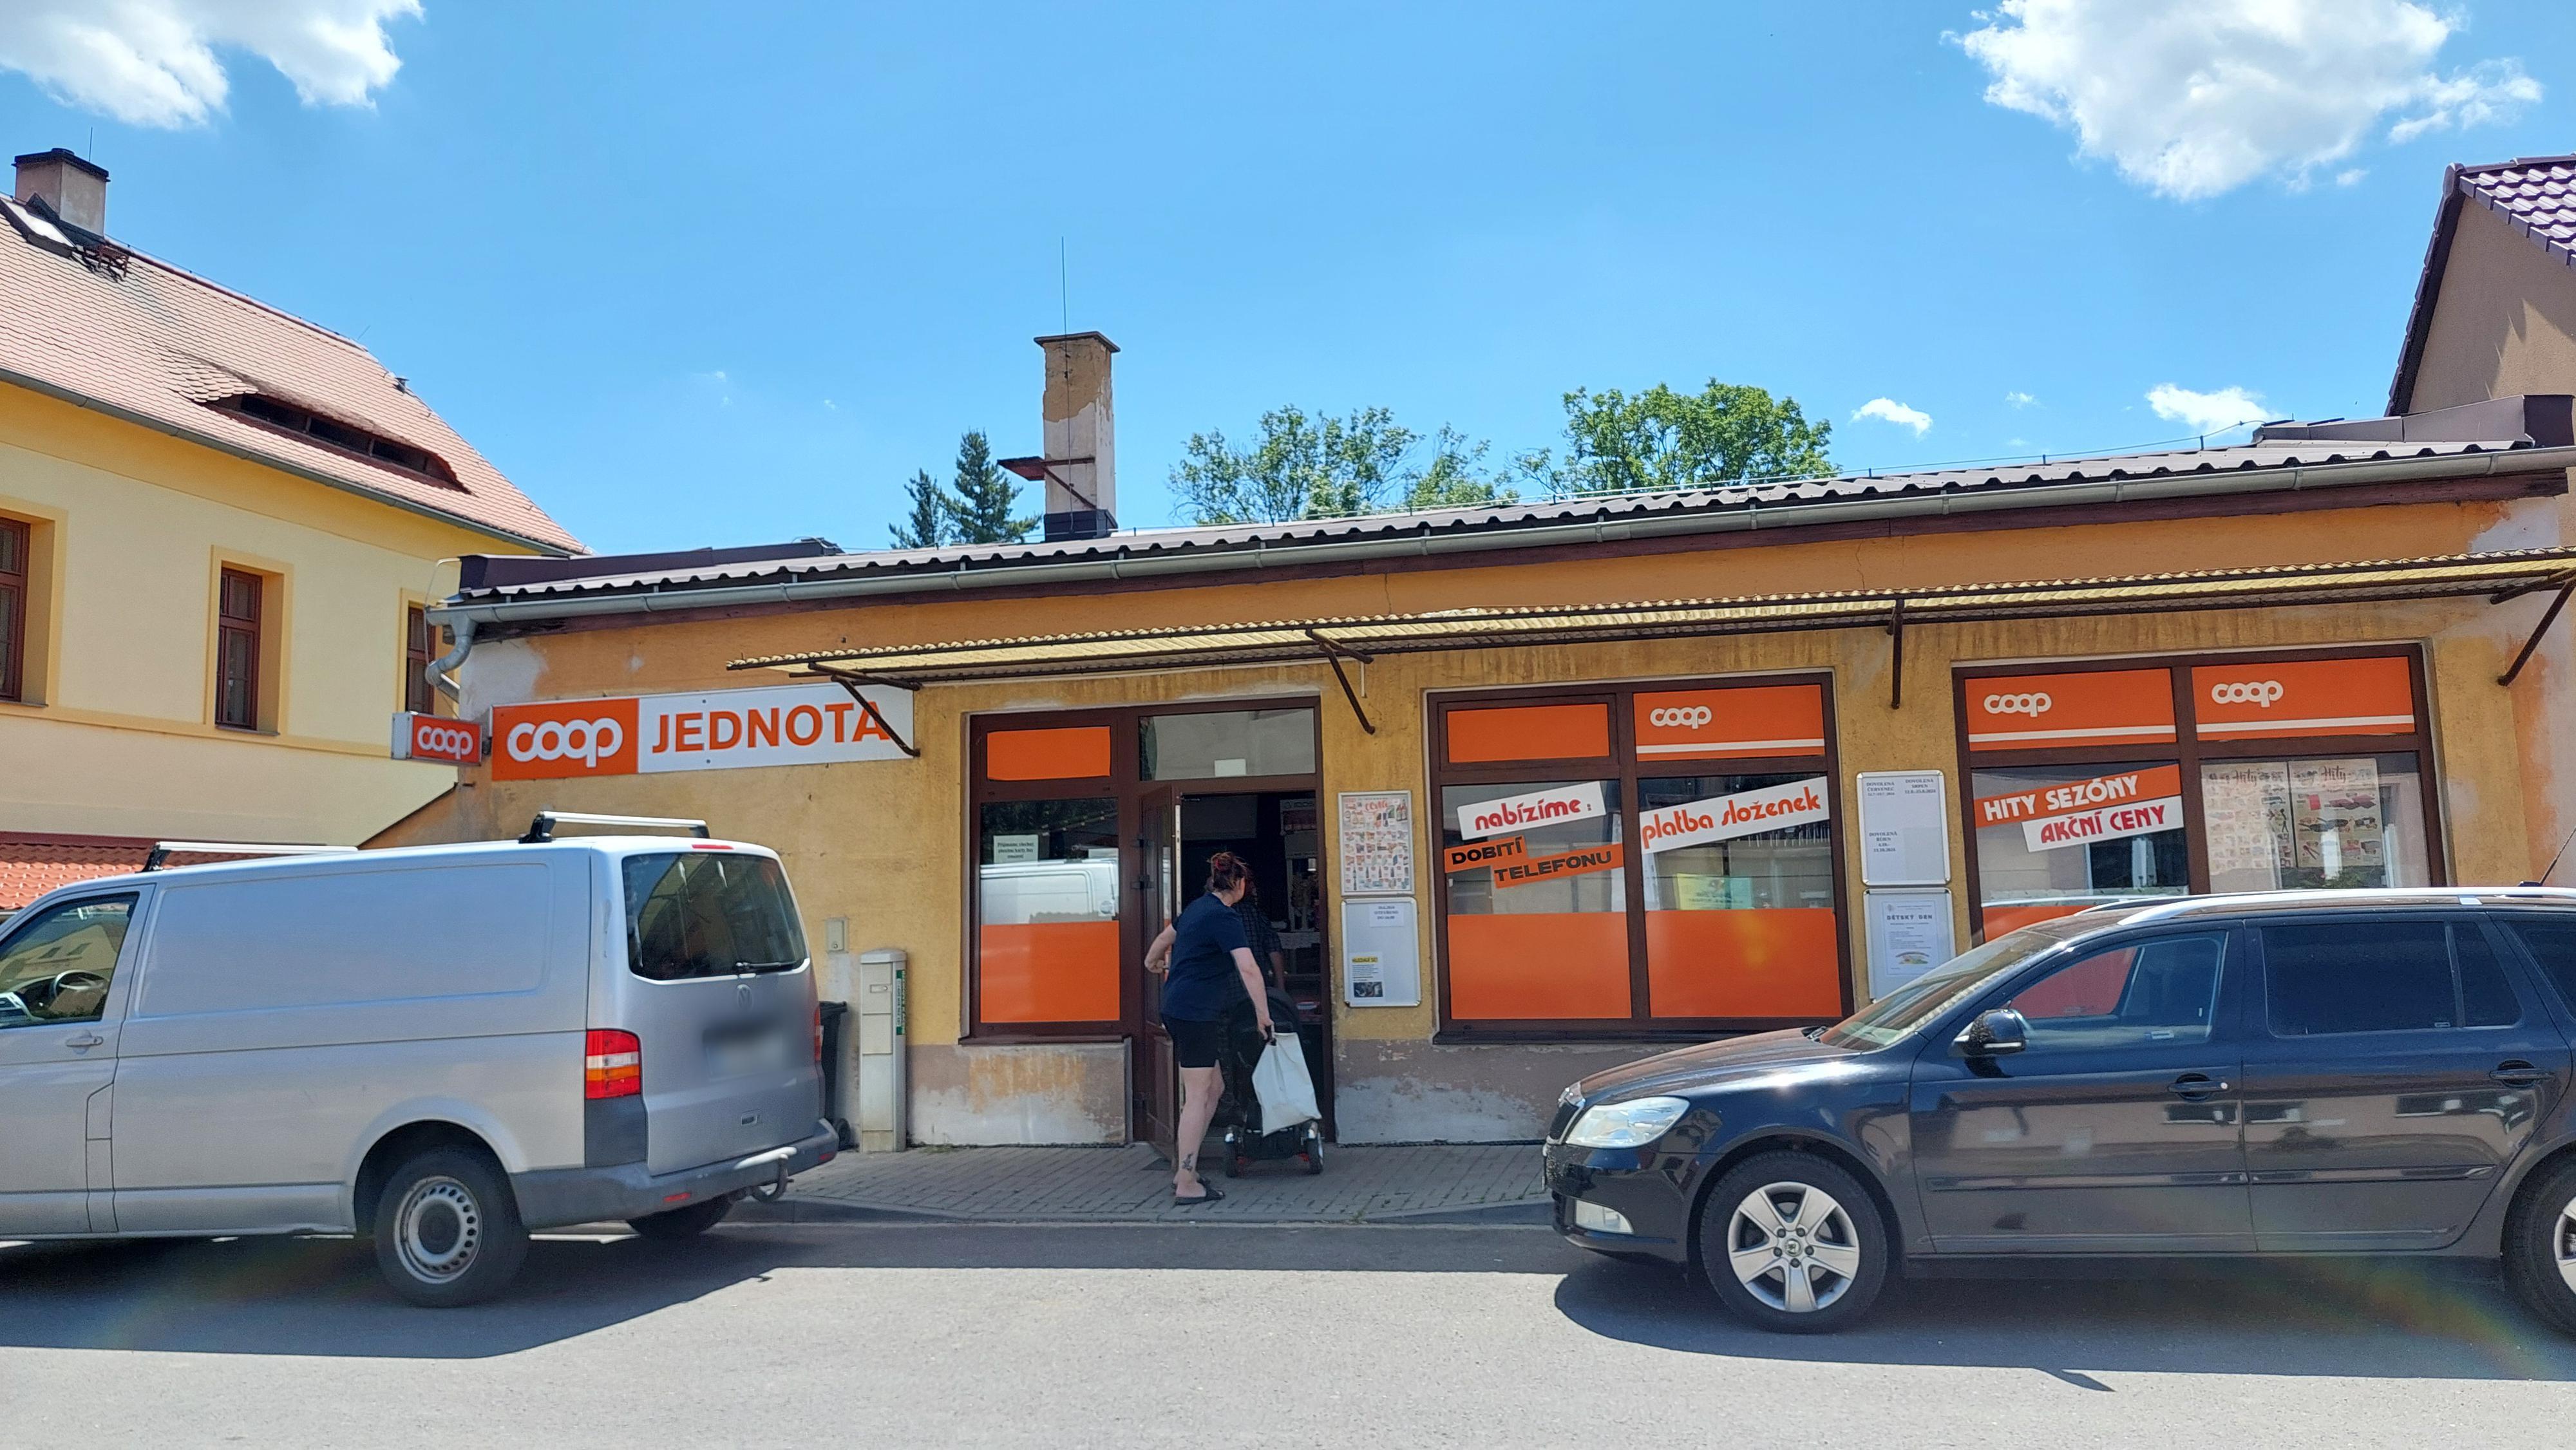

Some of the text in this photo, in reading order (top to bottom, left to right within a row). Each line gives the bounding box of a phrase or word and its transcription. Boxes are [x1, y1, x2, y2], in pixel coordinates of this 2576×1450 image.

[1984, 692, 2053, 717] coop
[2211, 680, 2284, 708] coop
[652, 701, 890, 754] JEDNOTA
[1650, 706, 1712, 730] coop
[416, 725, 473, 759] coop
[506, 717, 623, 767] coop
[1983, 774, 2139, 822] HITY SEZÓNY
[1641, 786, 1821, 850] platba složenek
[2040, 804, 2166, 844] AKČNÍ CENY
[1452, 836, 1522, 866] DOBITÍ
[1494, 851, 1612, 883] TELEFONU
